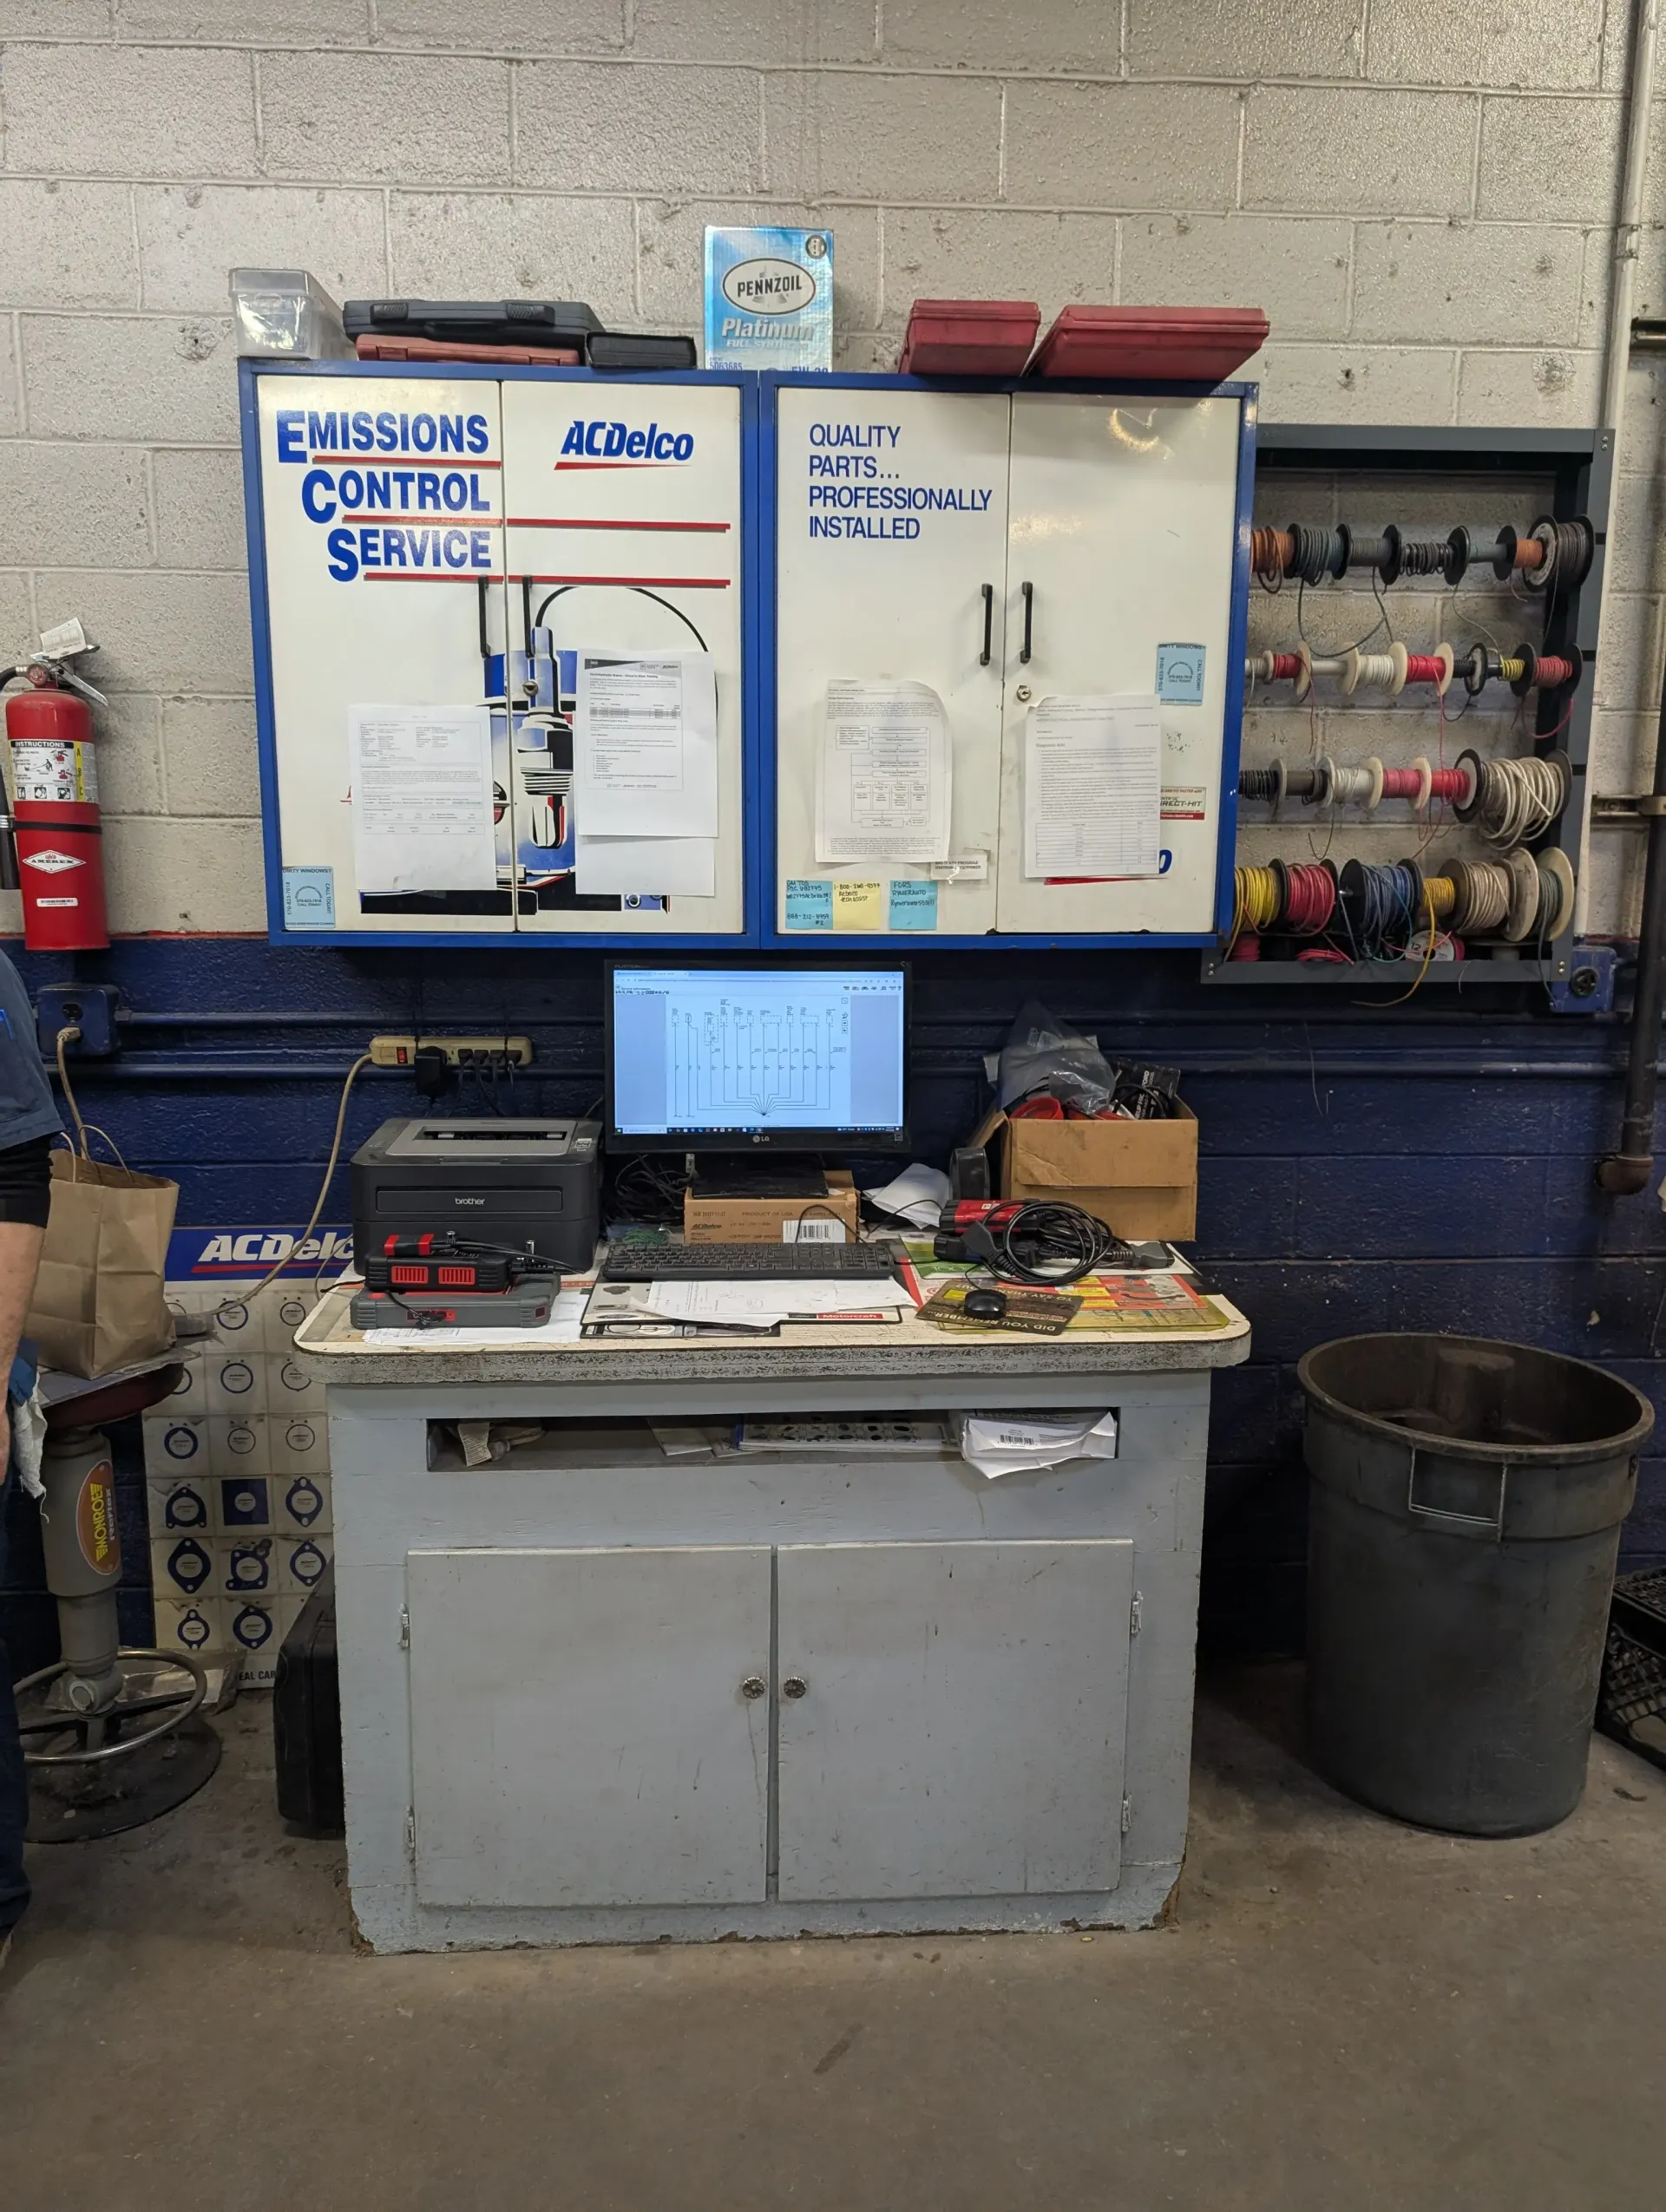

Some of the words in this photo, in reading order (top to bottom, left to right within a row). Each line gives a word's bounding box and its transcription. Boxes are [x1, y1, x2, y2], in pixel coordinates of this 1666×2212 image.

[738, 275, 802, 298] PENNZOIL
[722, 318, 814, 340] Platinum
[277, 410, 489, 463] EMISSIONS
[561, 421, 694, 461] ACDelco
[809, 424, 901, 448] QUALITY
[809, 455, 900, 479] PARTS...
[302, 469, 490, 524] CONTROL
[809, 485, 993, 511] PROFESSIONALLY
[809, 515, 920, 539] INSTALLED
[327, 528, 491, 581] SERVICE
[455, 1197, 485, 1206] brother
[198, 1233, 354, 1262] ACDelc
[90, 1489, 108, 1555] MONROE
